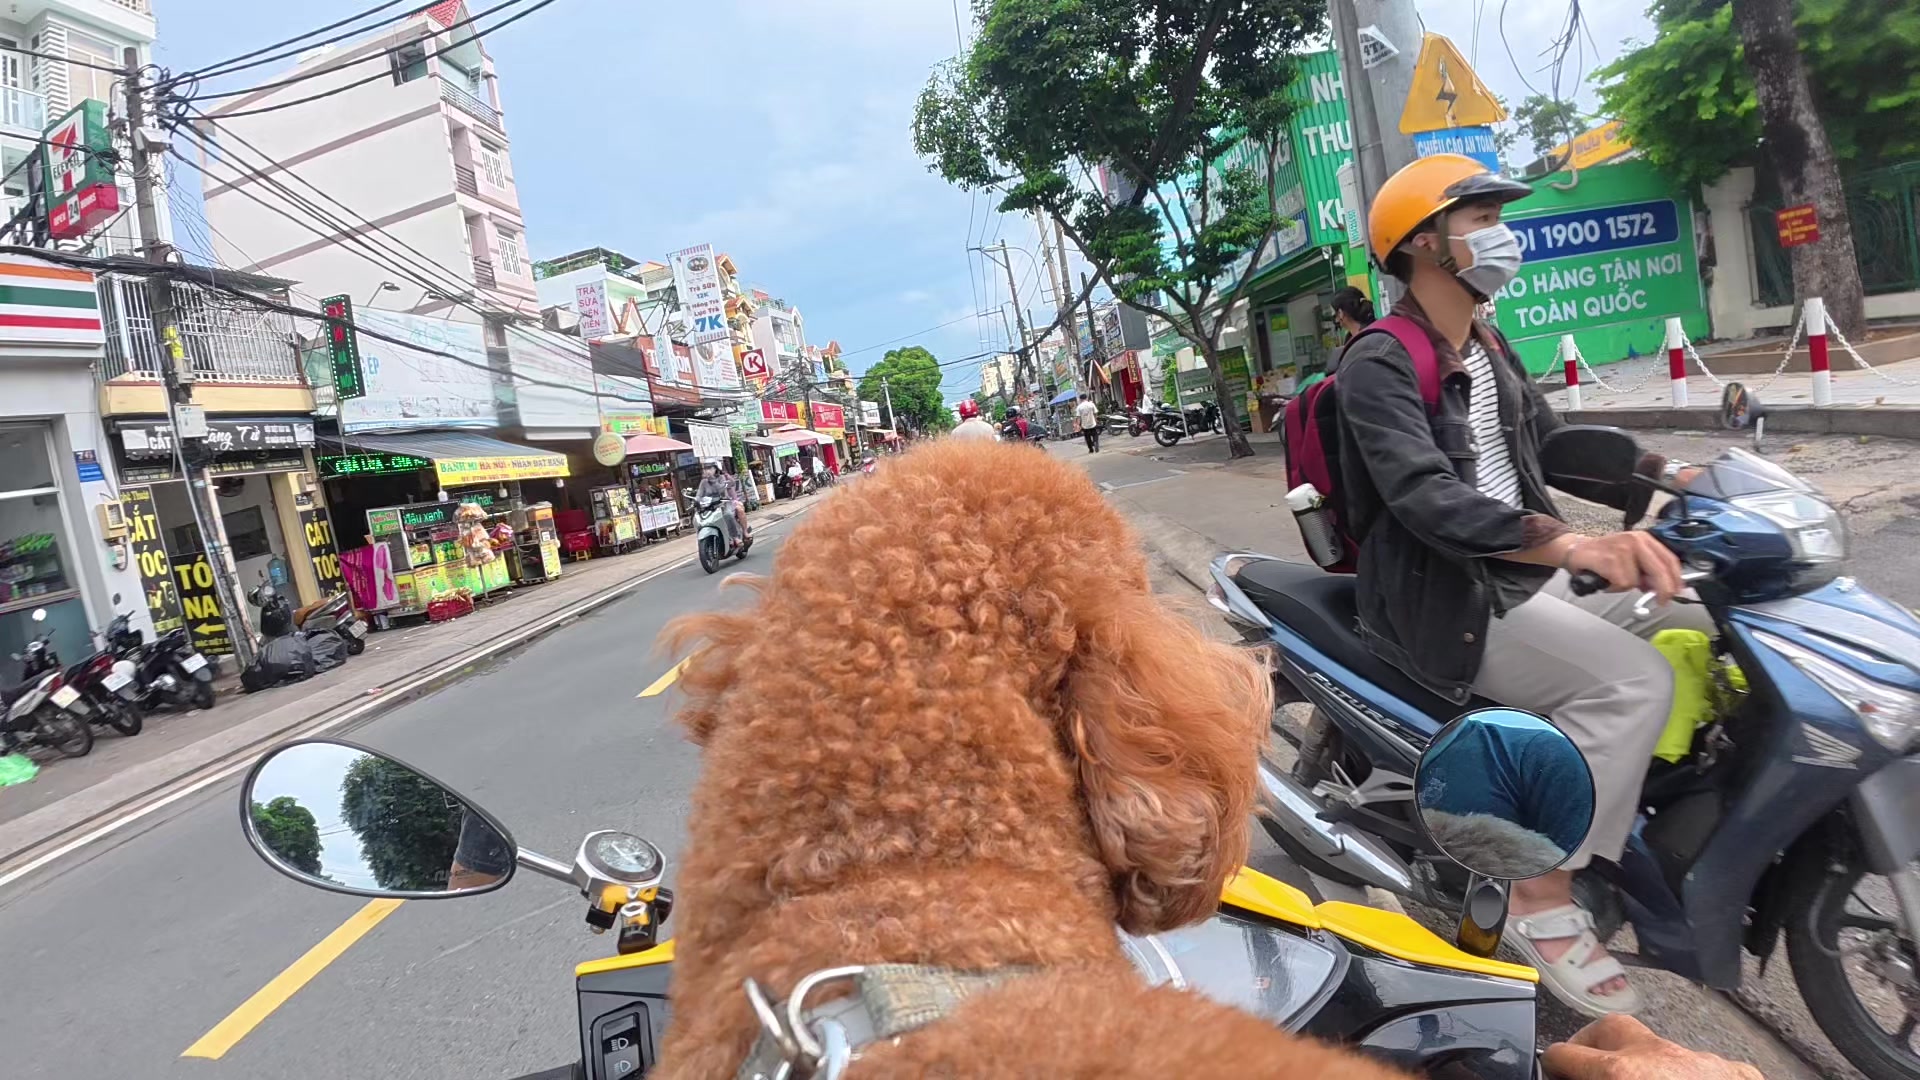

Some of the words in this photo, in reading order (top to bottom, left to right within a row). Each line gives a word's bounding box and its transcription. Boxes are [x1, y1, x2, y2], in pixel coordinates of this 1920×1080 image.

[1310, 70, 1346, 103] NH
[1302, 120, 1353, 157] THU
[1465, 137, 1477, 153] AN
[68, 199, 80, 219] 24
[1318, 198, 1346, 230] KH
[1541, 219, 1600, 249] 1900
[1605, 212, 1657, 240] 1572
[1494, 277, 1527, 301] AO
[1532, 266, 1597, 295] HÀNG
[1646, 252, 1683, 278] NƠI
[1515, 298, 1578, 329] TOÀN
[1583, 282, 1648, 318] QUỐC
[694, 314, 724, 333] 7K
[305, 511, 331, 547] CẮT
[424, 508, 444, 521] xanh
[174, 555, 213, 590] TÓ
[312, 549, 341, 580] TÓC
[183, 594, 223, 620] NA
[1306, 671, 1401, 730] FUTURE
